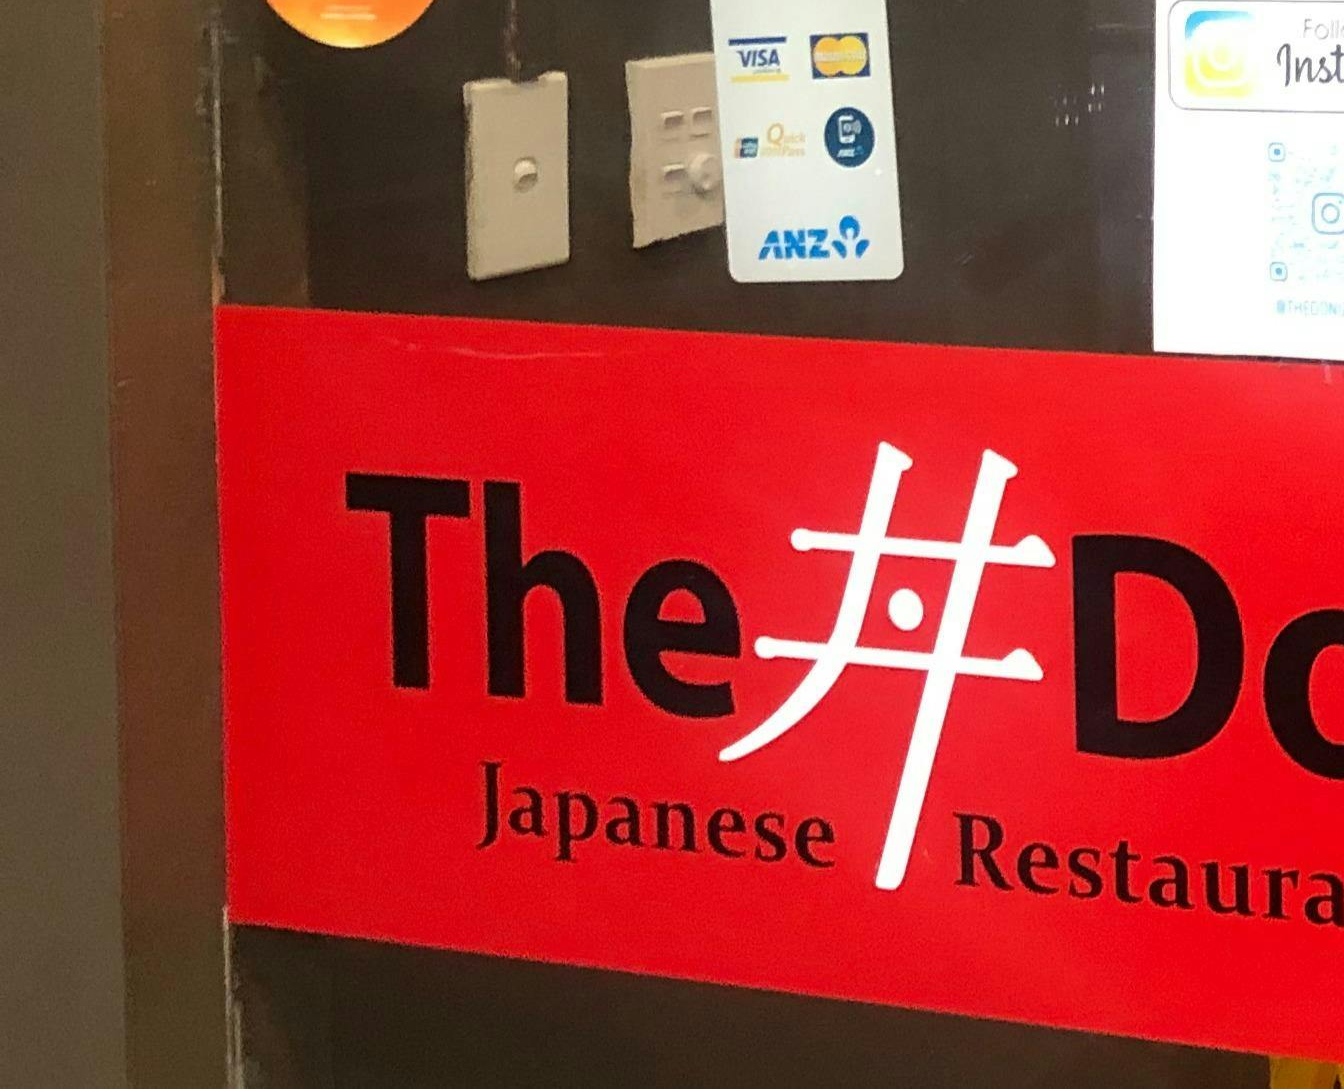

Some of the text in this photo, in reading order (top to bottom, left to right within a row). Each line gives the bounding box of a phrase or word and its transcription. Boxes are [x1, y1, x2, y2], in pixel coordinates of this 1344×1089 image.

[737, 49, 781, 68] VISA
[758, 228, 830, 261] ANZ
[345, 471, 742, 719] The
[475, 760, 837, 869] Japanese
